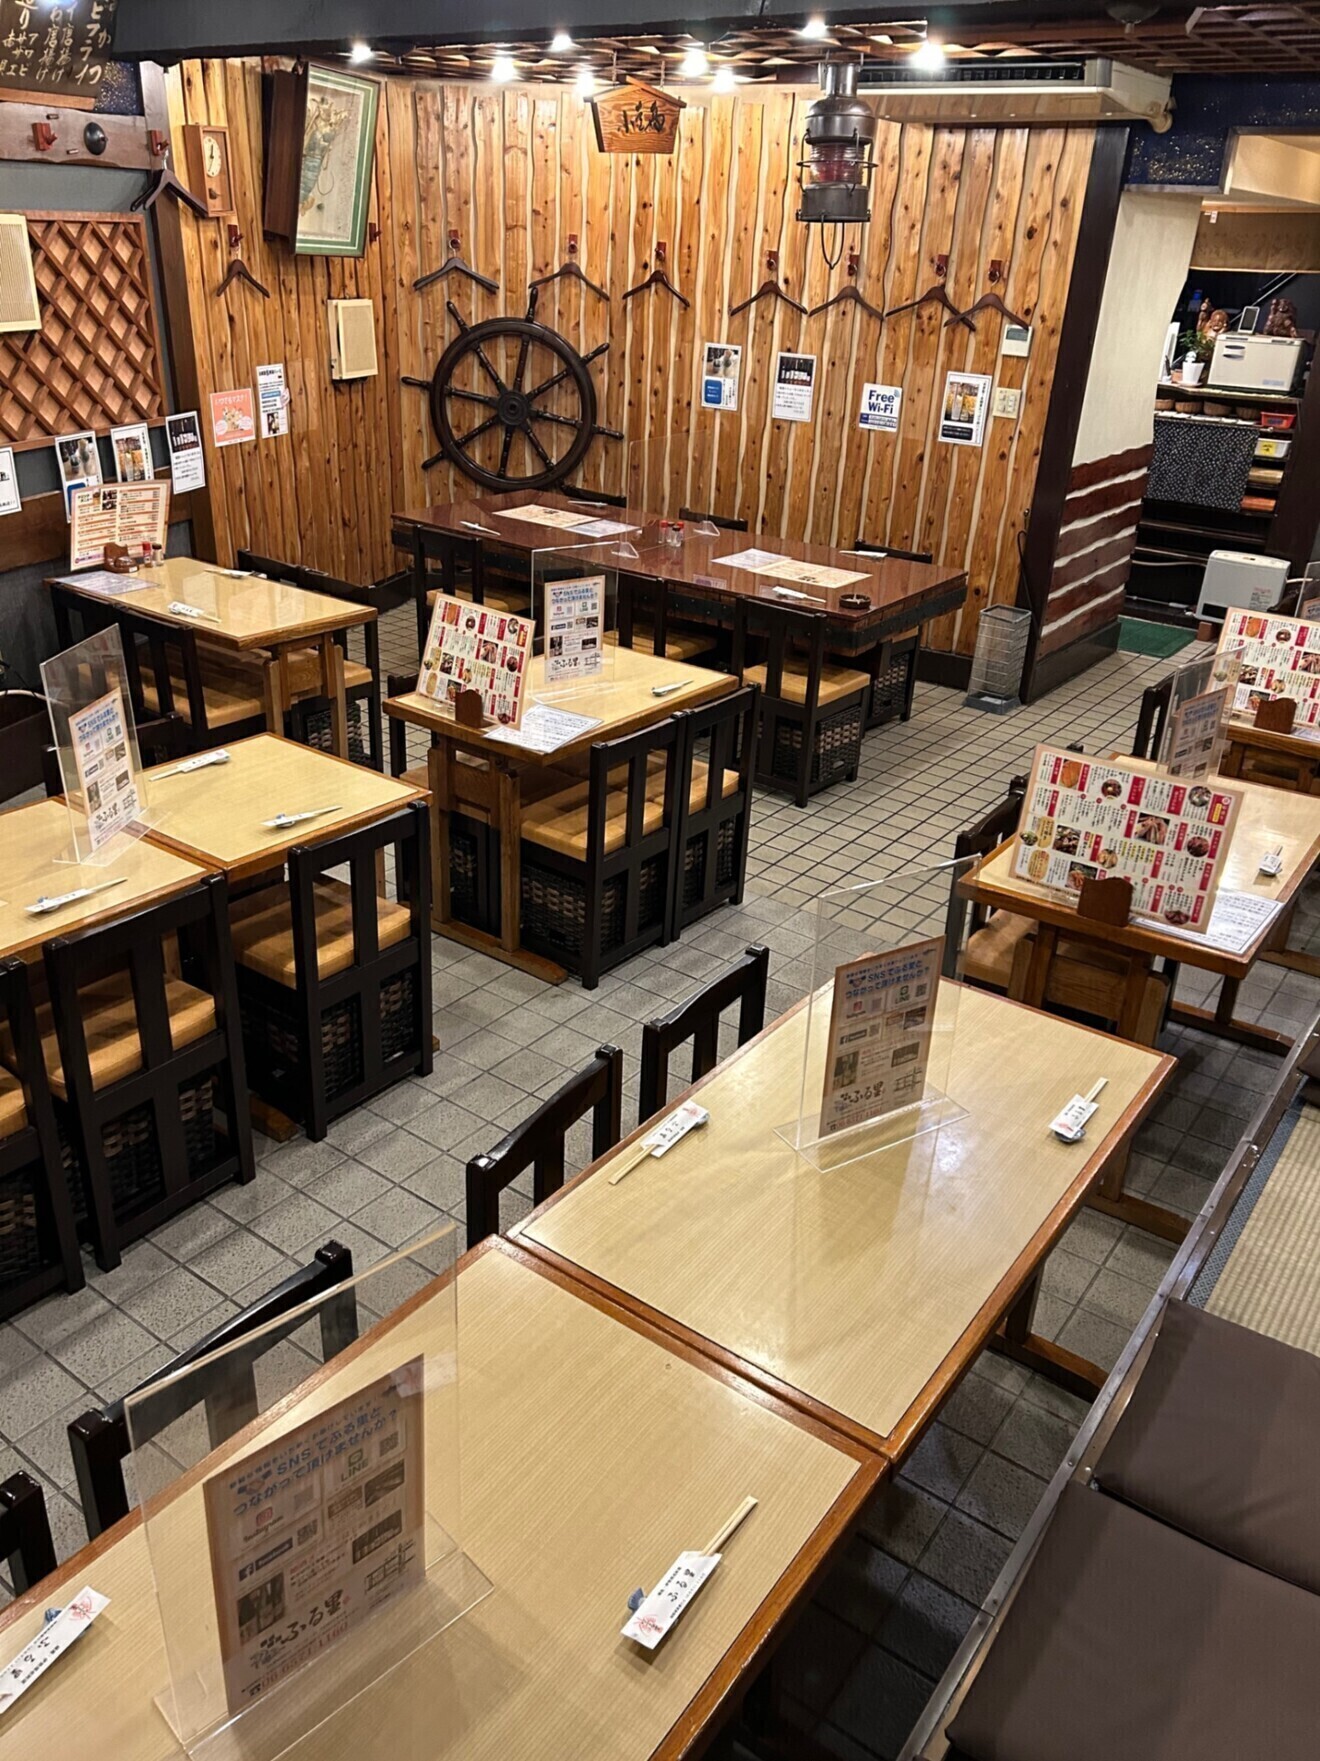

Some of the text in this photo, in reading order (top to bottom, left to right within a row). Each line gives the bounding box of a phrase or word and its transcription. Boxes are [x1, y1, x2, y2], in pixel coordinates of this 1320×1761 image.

[868, 389, 895, 403] Free
[868, 401, 894, 414] Wi-Fi
[340, 1458, 369, 1483] LINE
[667, 1568, 696, 1603] ふる里
